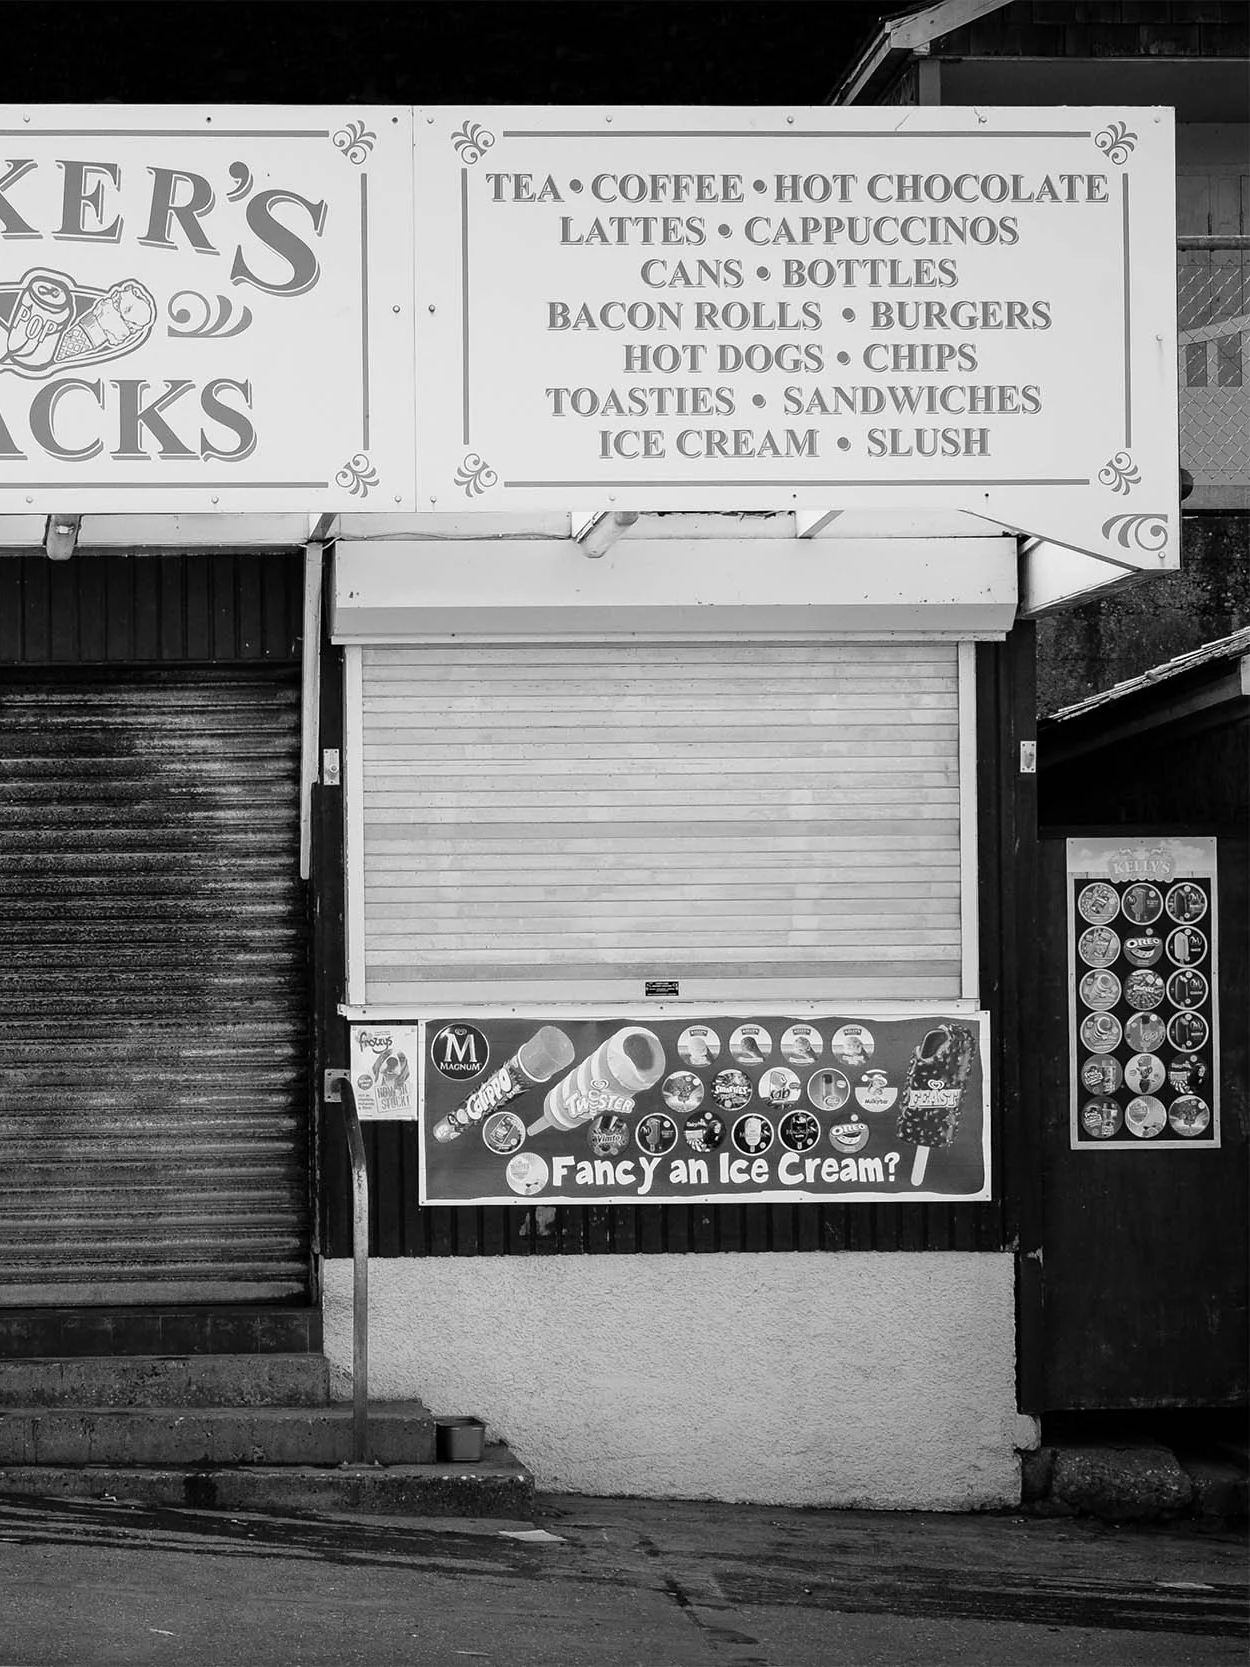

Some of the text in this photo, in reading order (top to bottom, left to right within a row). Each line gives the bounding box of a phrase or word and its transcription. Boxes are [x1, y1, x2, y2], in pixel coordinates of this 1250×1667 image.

[486, 174, 1109, 203] TEA COFFEE HOT CHOCOLATE
[560, 216, 1019, 246] LATTES CAPPUCCINOS
[641, 258, 958, 288] CANS BOTTLES
[13, 305, 57, 343] POP
[547, 301, 1052, 331] BACON ROLLS BURGERS
[624, 343, 978, 373] HOT DOGS CHIPS
[545, 385, 1042, 417] TOASTIES SANDWICHES
[599, 428, 991, 459] ICE CREAM SLUSH
[1114, 861, 1171, 874] KELLY'S
[440, 1061, 480, 1071] MAGNUM
[909, 1089, 962, 1109] FEAST
[552, 1156, 662, 1194] Fancy
[669, 1157, 710, 1184] an
[719, 1152, 769, 1184] Ice
[778, 1152, 900, 1184] Cream?
